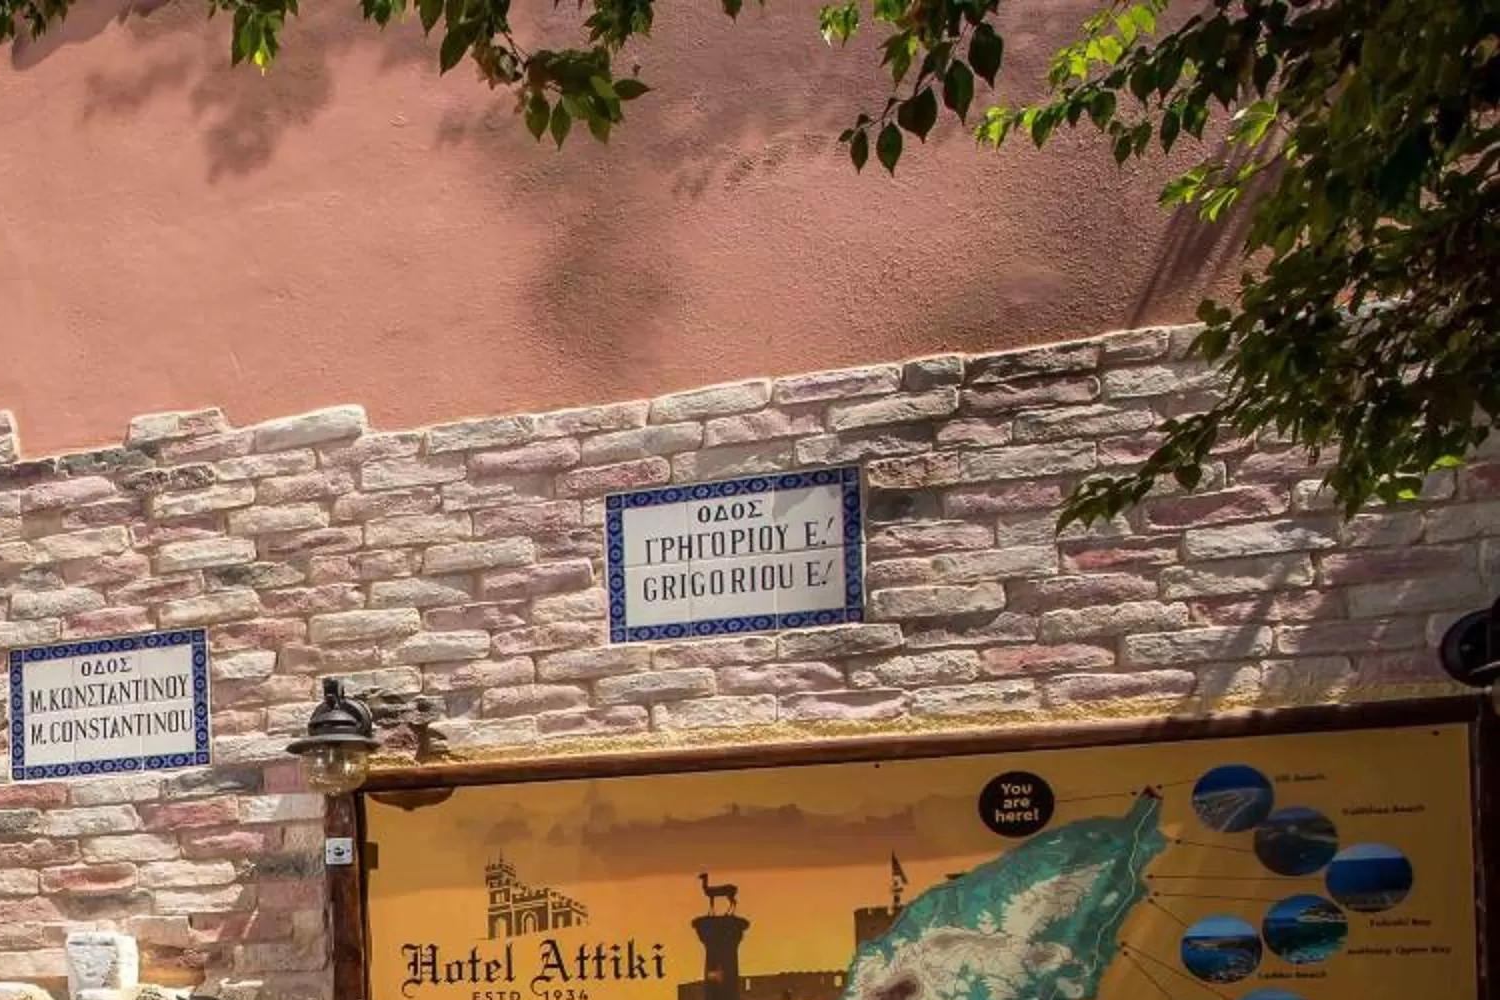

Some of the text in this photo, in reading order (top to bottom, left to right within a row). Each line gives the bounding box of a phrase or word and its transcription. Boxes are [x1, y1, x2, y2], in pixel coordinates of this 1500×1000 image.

[697, 500, 763, 523] ΟΔΟΣ
[644, 523, 789, 564] ΓΡΗΓΟΡΙΟΥ
[643, 562, 793, 602] GRIGORIOU
[81, 657, 132, 677] ΟΔΟΣ
[1001, 783, 1033, 795] You
[1003, 797, 1030, 809] are
[995, 808, 1040, 824] here!
[401, 938, 666, 998] Hotel Attiki
